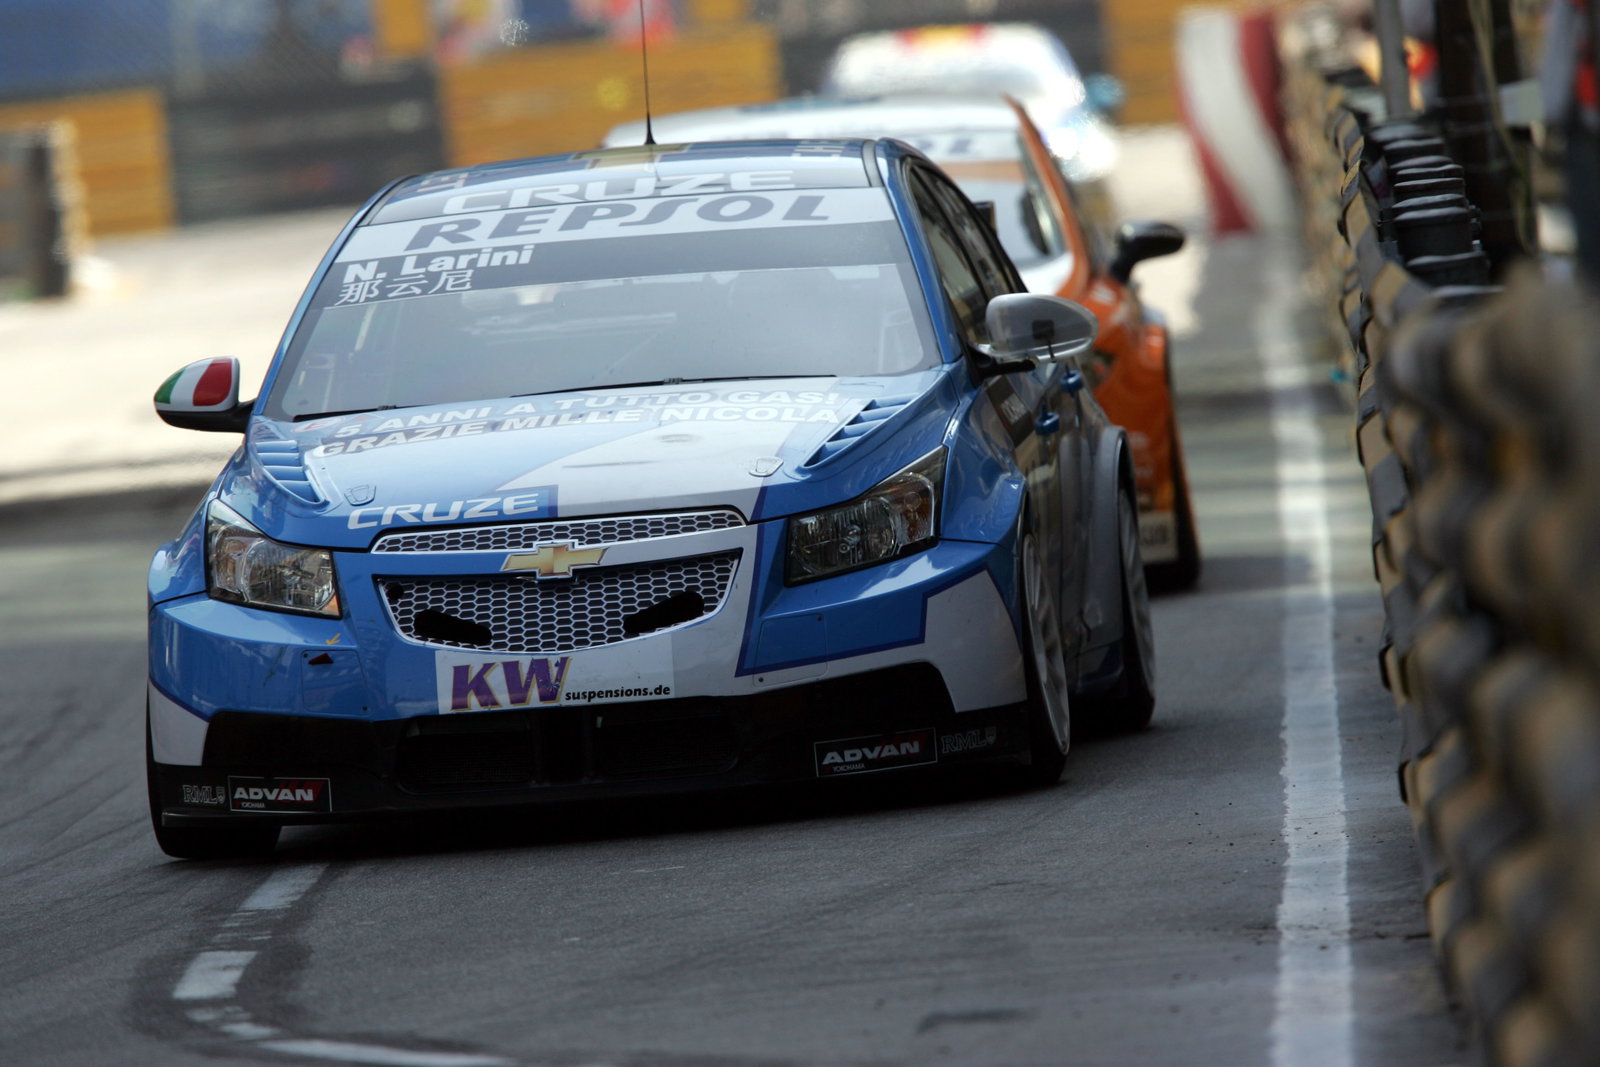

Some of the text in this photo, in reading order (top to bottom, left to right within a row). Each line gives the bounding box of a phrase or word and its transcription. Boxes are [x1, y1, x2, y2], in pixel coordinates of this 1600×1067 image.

[443, 169, 795, 216] CRUZE
[404, 193, 830, 253] REPSOL
[343, 245, 535, 284] N. Larini
[335, 269, 474, 306] 那云尼
[315, 407, 840, 457] GRAZIE MILLE NICOLA
[336, 391, 840, 438] 5 ANNI A TUTTO GAS!
[347, 490, 539, 530] CRUZE
[451, 656, 671, 711] KW suspensions.de
[822, 741, 919, 765] ADVAN
[941, 729, 987, 754] RML
[182, 784, 218, 804] RML
[233, 787, 314, 801] ADVAN
